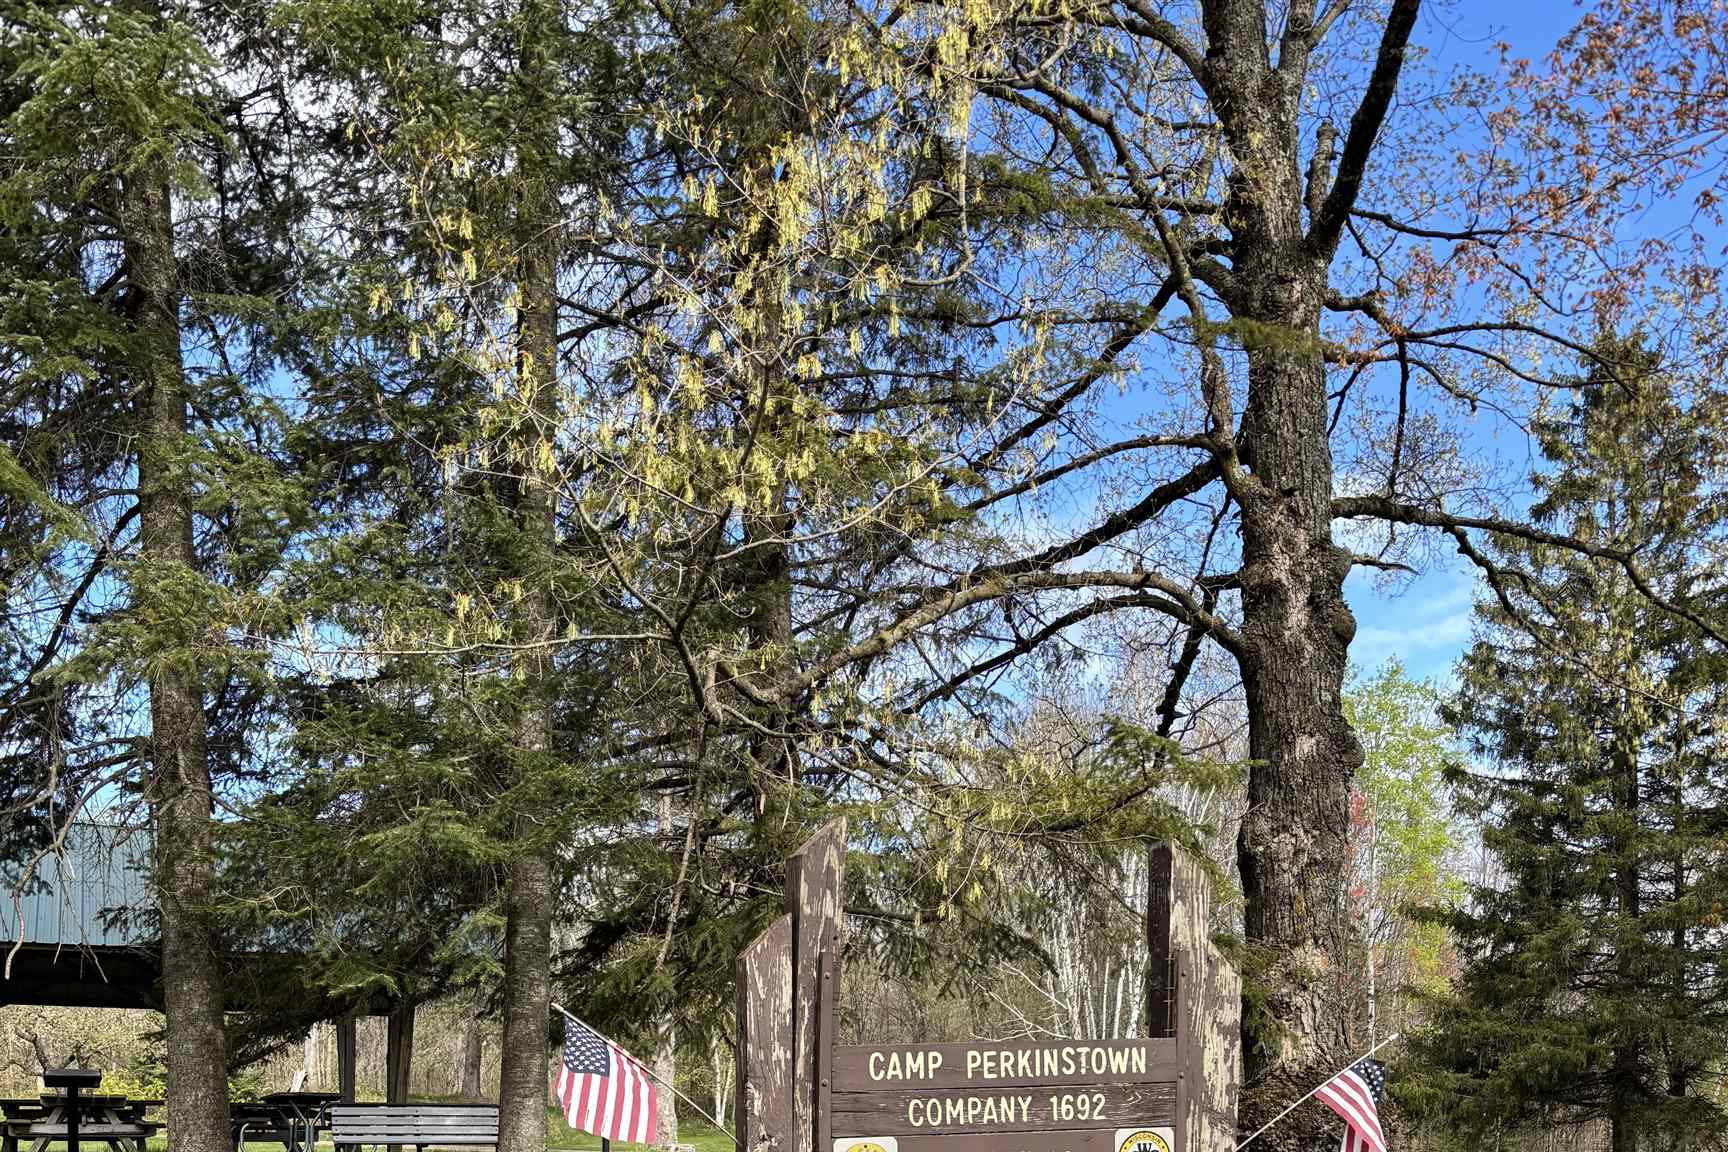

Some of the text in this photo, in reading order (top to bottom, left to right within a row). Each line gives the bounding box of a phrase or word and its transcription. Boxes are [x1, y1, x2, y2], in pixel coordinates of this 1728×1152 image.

[869, 1046, 1147, 1081] CAMP PERKINSTOWN
[908, 1093, 1107, 1127] COMPANY 1692
